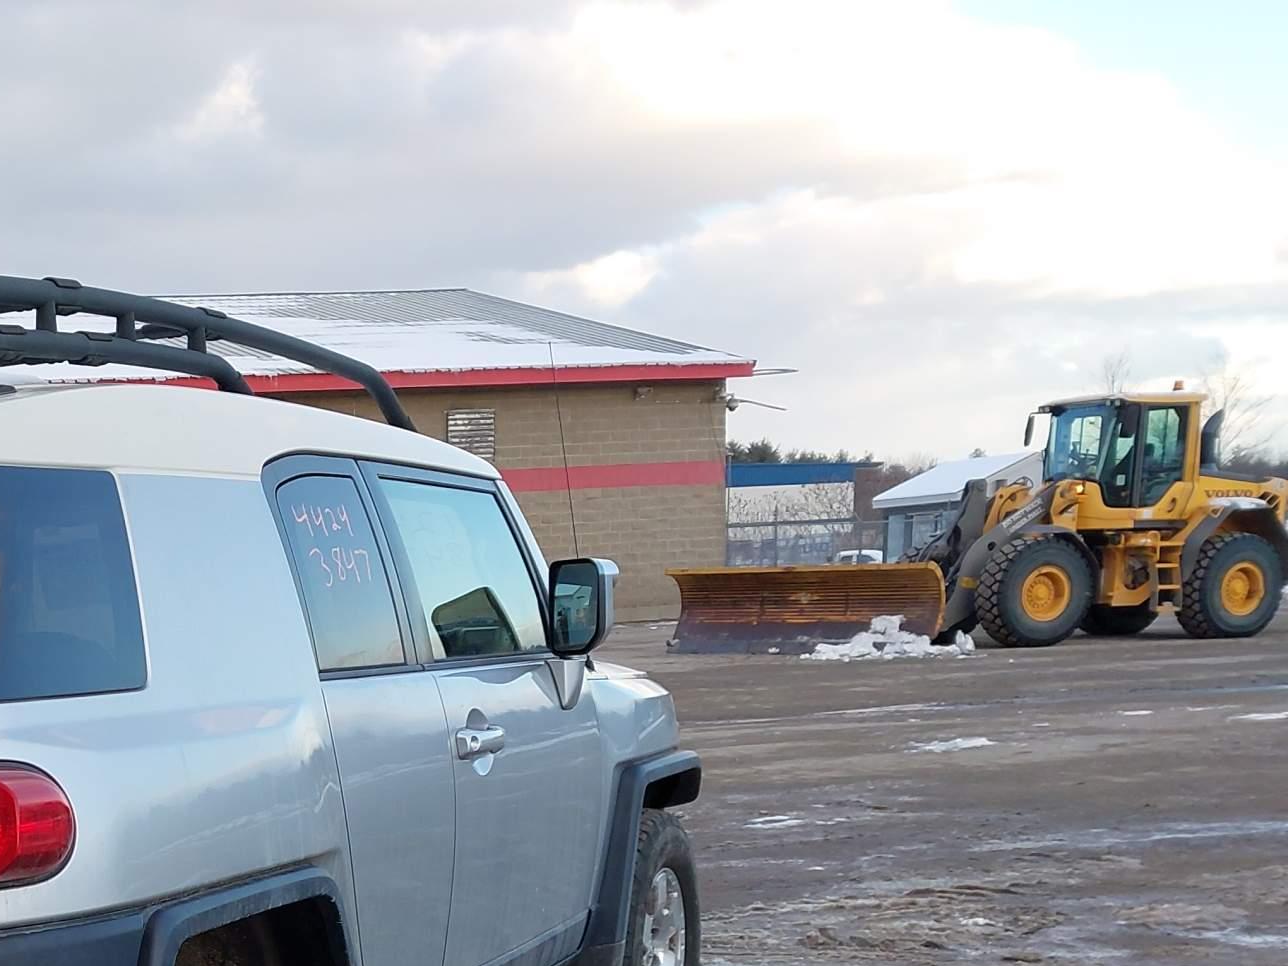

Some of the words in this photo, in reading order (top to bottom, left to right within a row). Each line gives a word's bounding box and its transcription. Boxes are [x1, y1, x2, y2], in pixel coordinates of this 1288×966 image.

[1204, 489, 1253, 498] VOLVO
[291, 503, 354, 536] 4424
[309, 546, 372, 587] 3847
